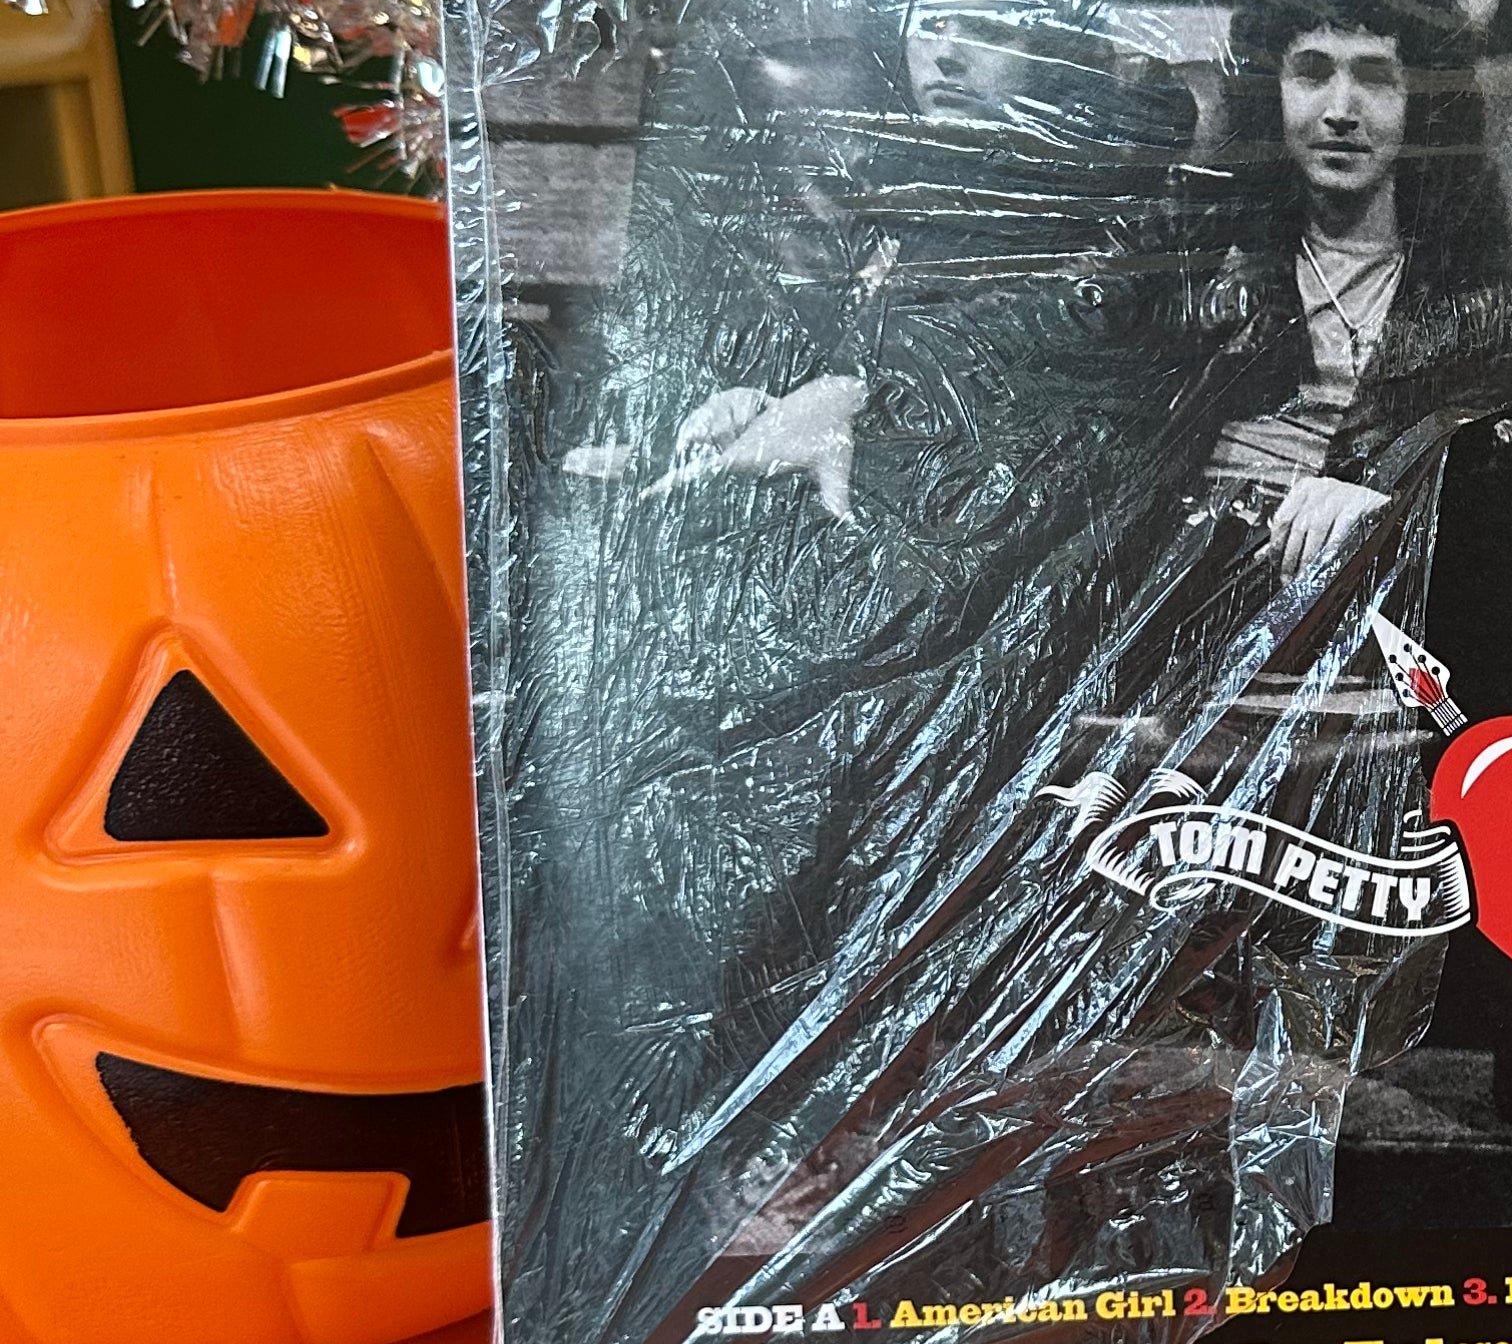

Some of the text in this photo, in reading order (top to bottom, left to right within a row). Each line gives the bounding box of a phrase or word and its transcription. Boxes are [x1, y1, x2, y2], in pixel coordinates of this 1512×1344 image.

[1149, 817, 1267, 875] TOM
[1277, 842, 1432, 922] PETTY
[697, 1304, 803, 1335] SIDE
[812, 1305, 845, 1332] A
[891, 1297, 1088, 1329] American
[1095, 1289, 1176, 1321] Girl
[1184, 1288, 1217, 1316] 2.
[1225, 1282, 1455, 1315] Breakdown
[1463, 1277, 1498, 1306] 3.
